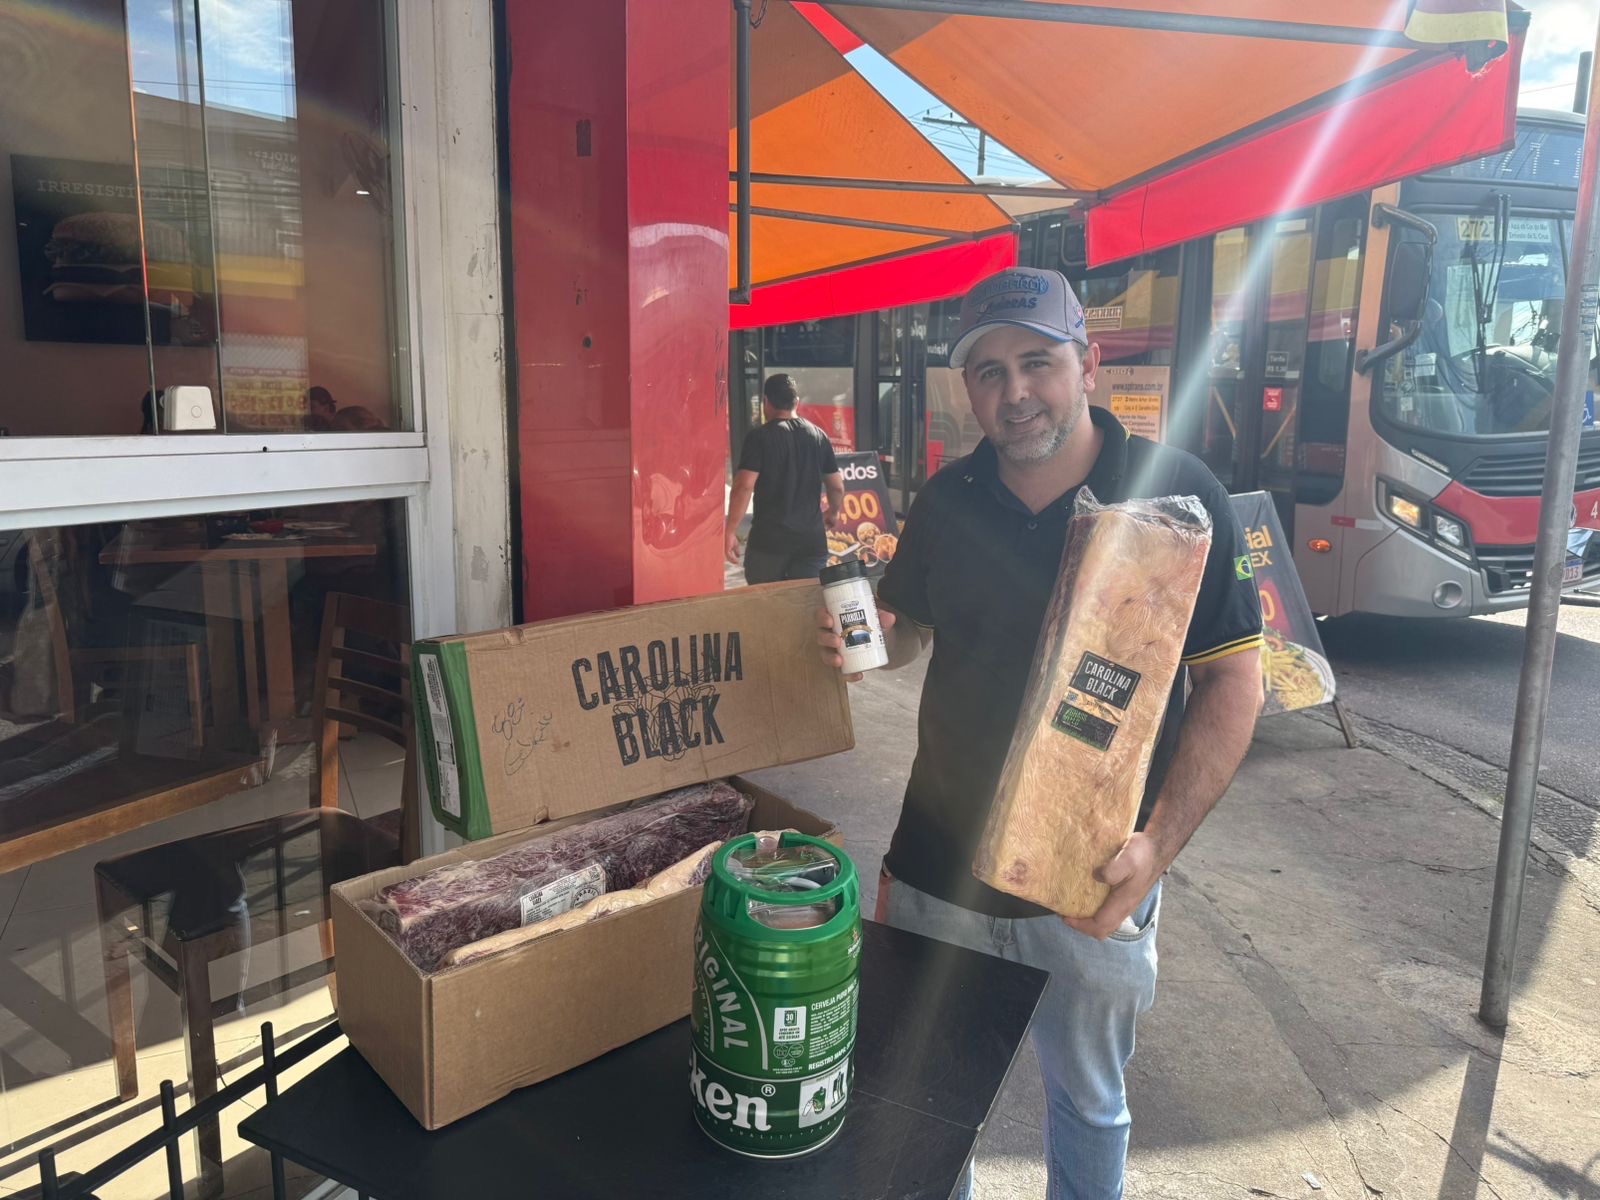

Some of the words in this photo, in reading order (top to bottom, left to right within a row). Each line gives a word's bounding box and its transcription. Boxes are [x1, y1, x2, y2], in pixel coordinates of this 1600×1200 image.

[838, 492, 879, 525] ,00
[570, 631, 744, 711] CAROLINA
[1084, 661, 1132, 691] CAROLINA
[1085, 677, 1119, 701] BLACK
[611, 693, 726, 767] BLACK
[811, 996, 836, 1011] CERVEJA
[785, 1013, 794, 1022] 30
[808, 1056, 834, 1070] REGISTRO
